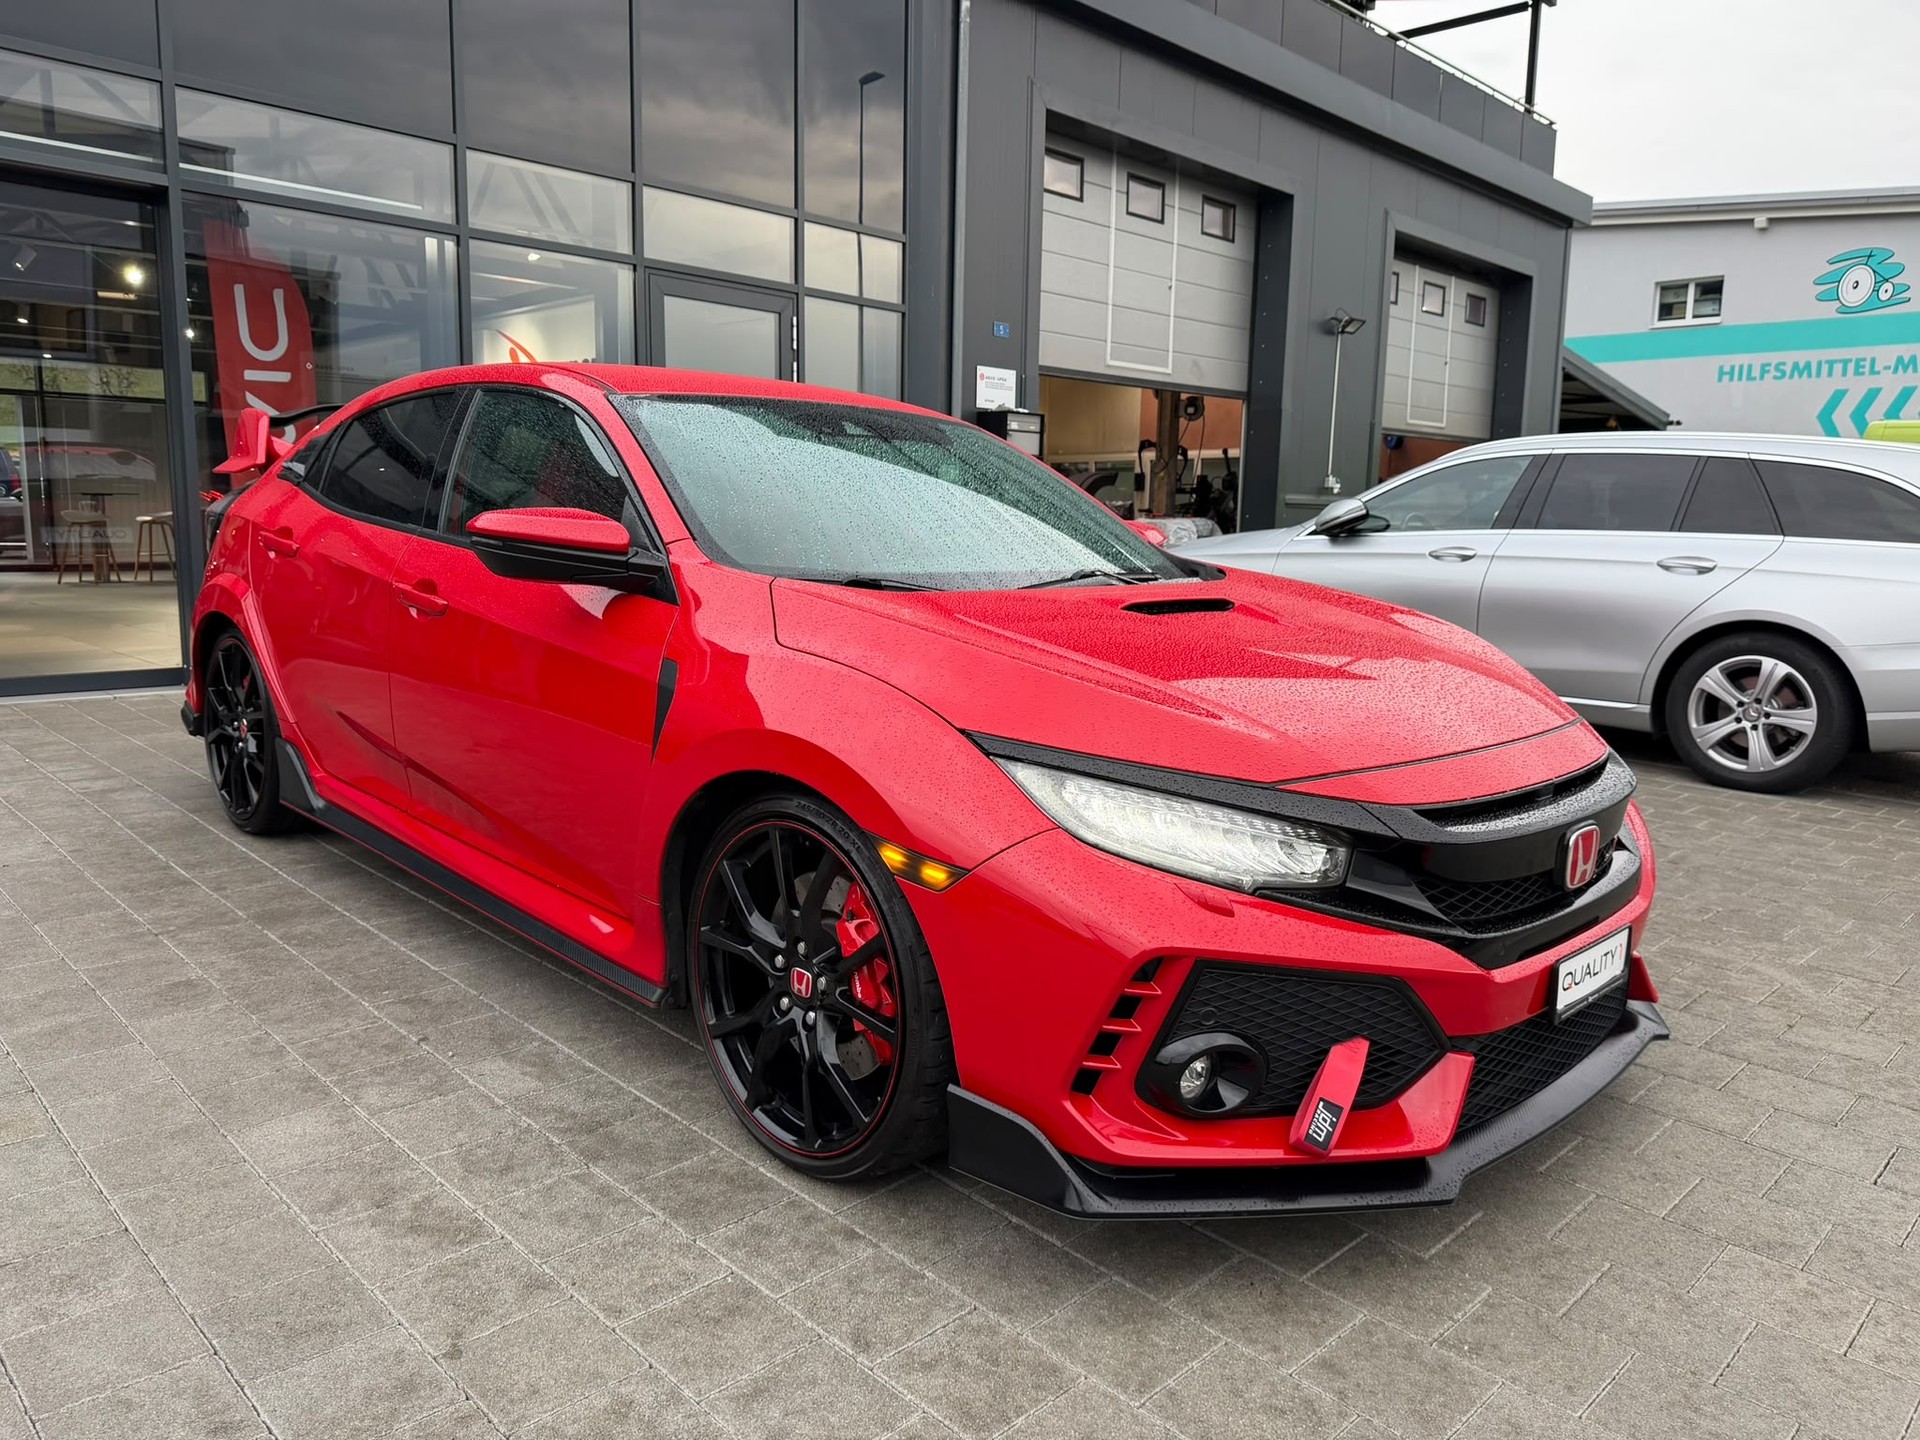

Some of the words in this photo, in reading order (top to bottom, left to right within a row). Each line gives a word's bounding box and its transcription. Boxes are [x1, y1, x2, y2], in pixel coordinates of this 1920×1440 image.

[1000, 325, 1004, 335] 5
[234, 284, 297, 443] VIC
[1717, 354, 1919, 383] HILFSMITTEL-M
[853, 971, 862, 999] rembo
